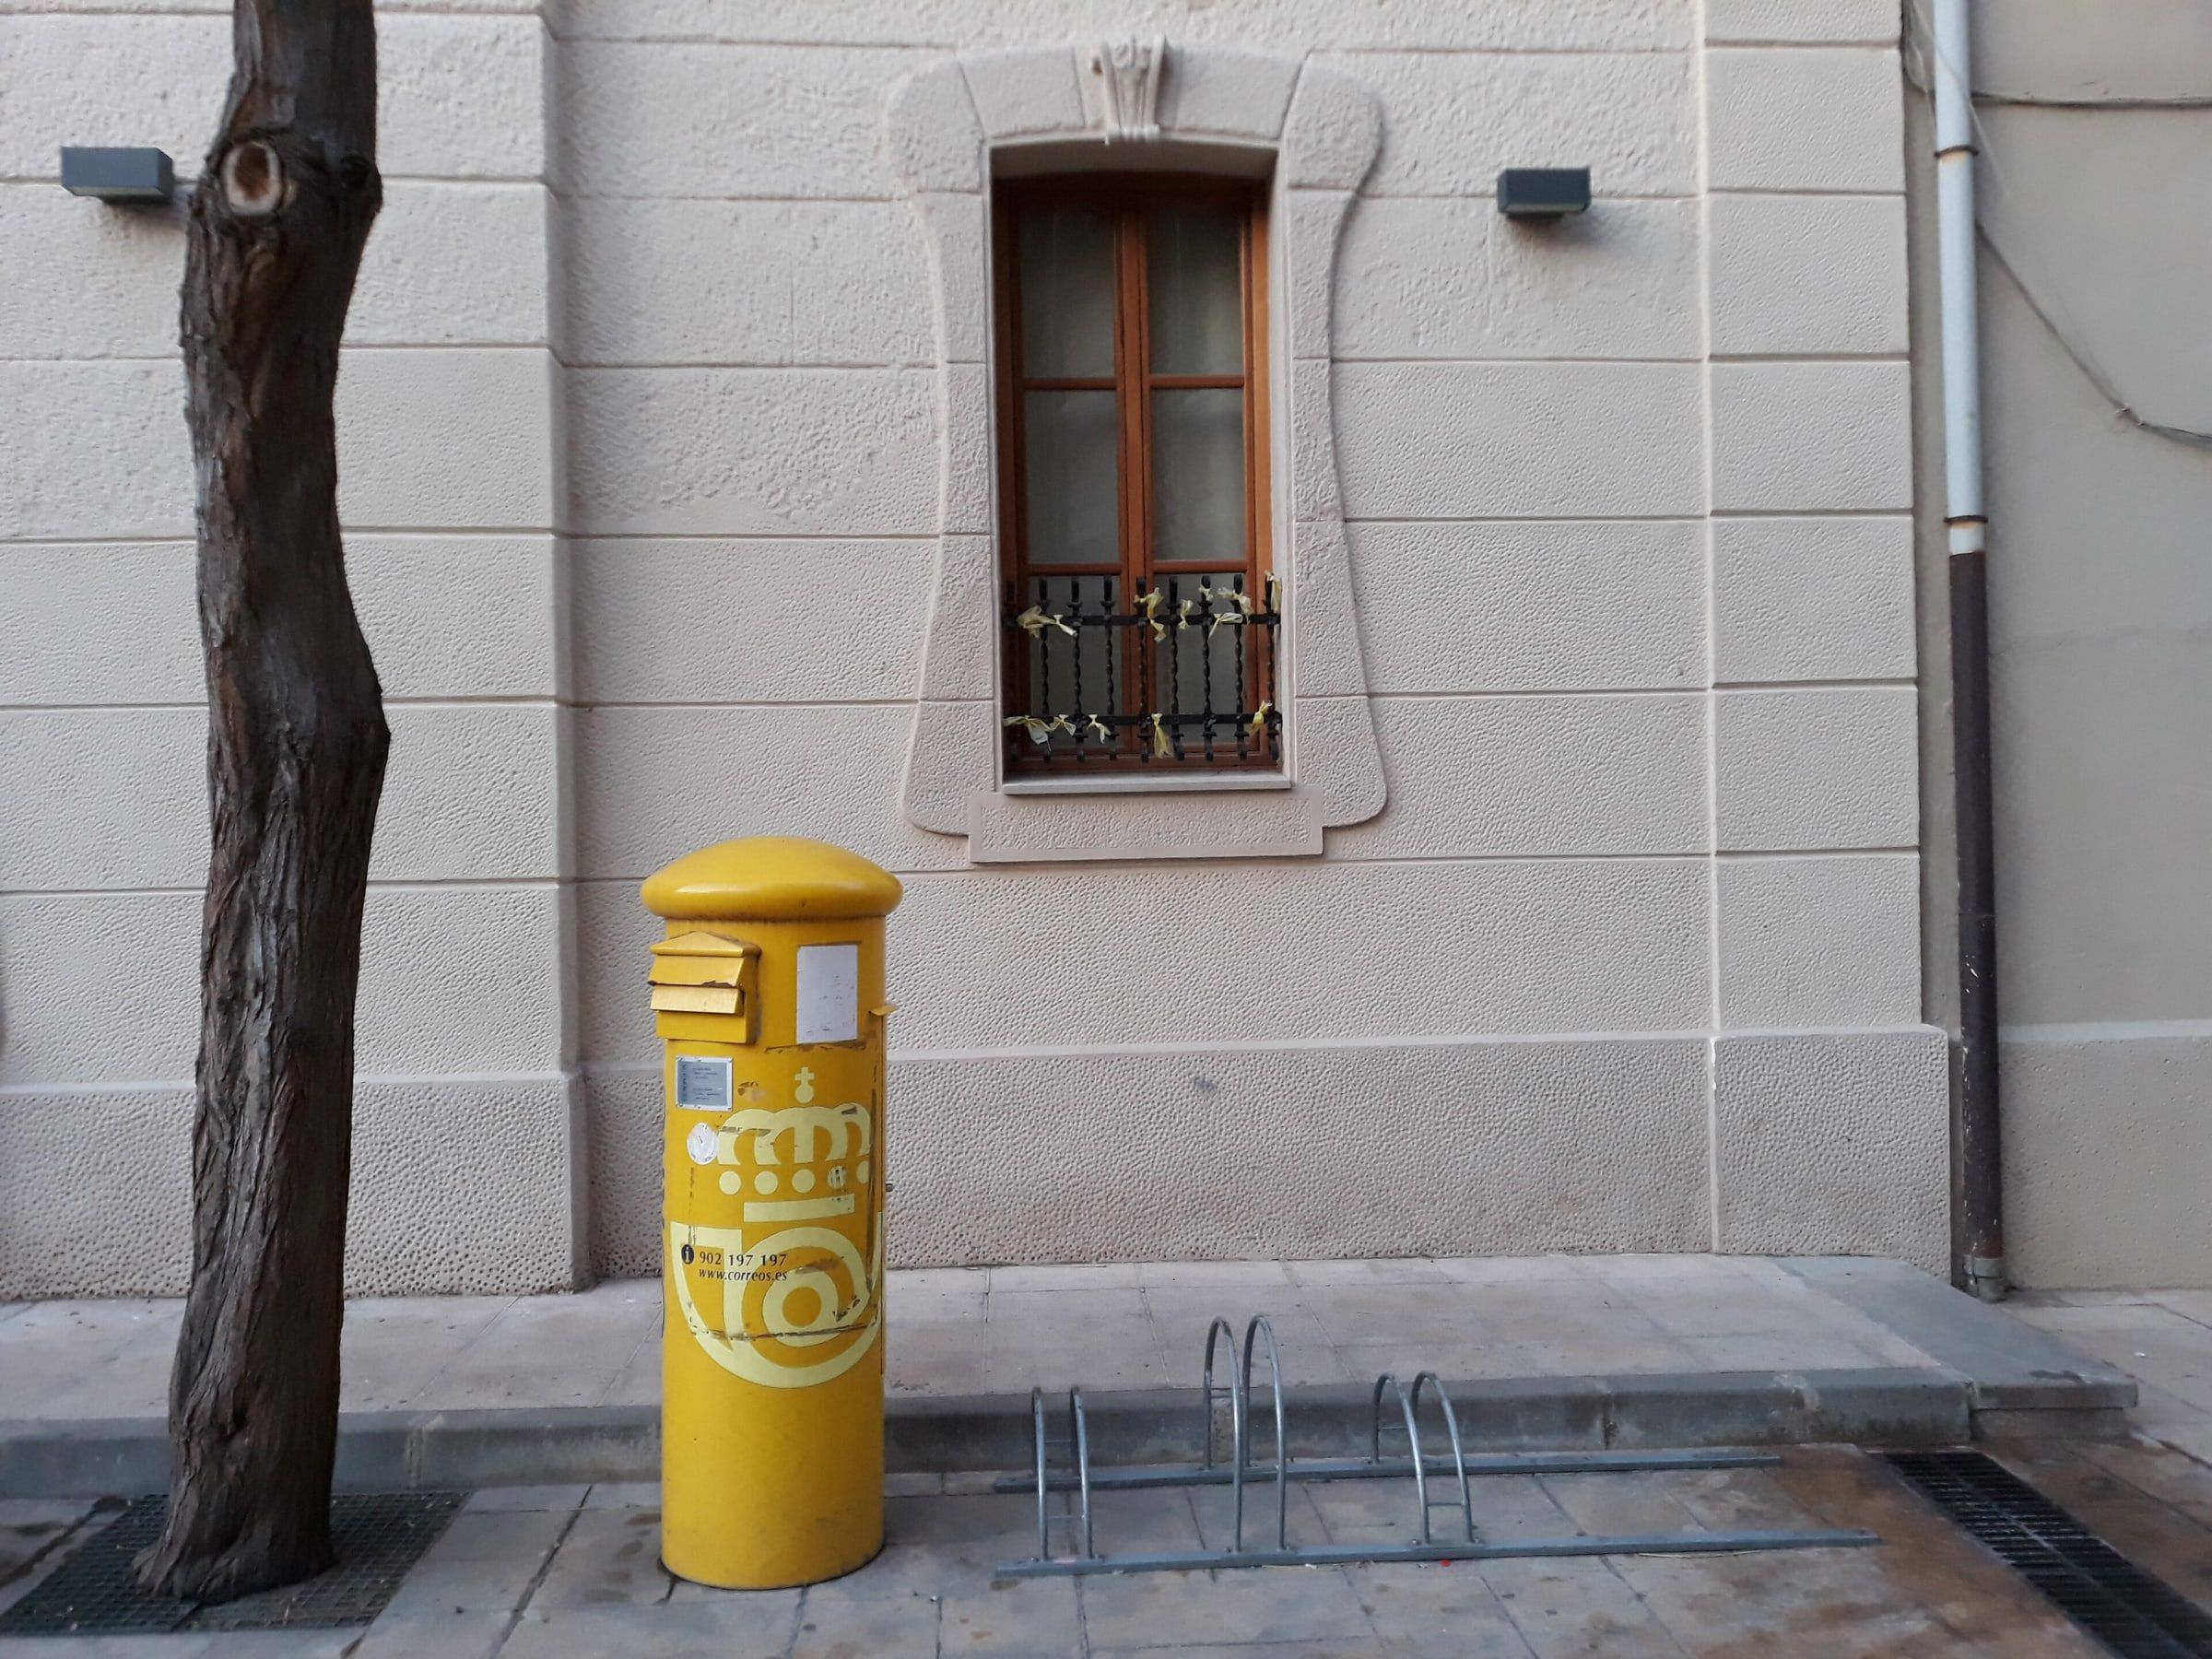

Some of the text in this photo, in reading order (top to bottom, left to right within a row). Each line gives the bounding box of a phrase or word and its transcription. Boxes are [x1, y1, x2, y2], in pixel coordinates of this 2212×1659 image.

[699, 1252, 787, 1267] 902 197 197
[699, 1268, 788, 1282] www.correos.es
